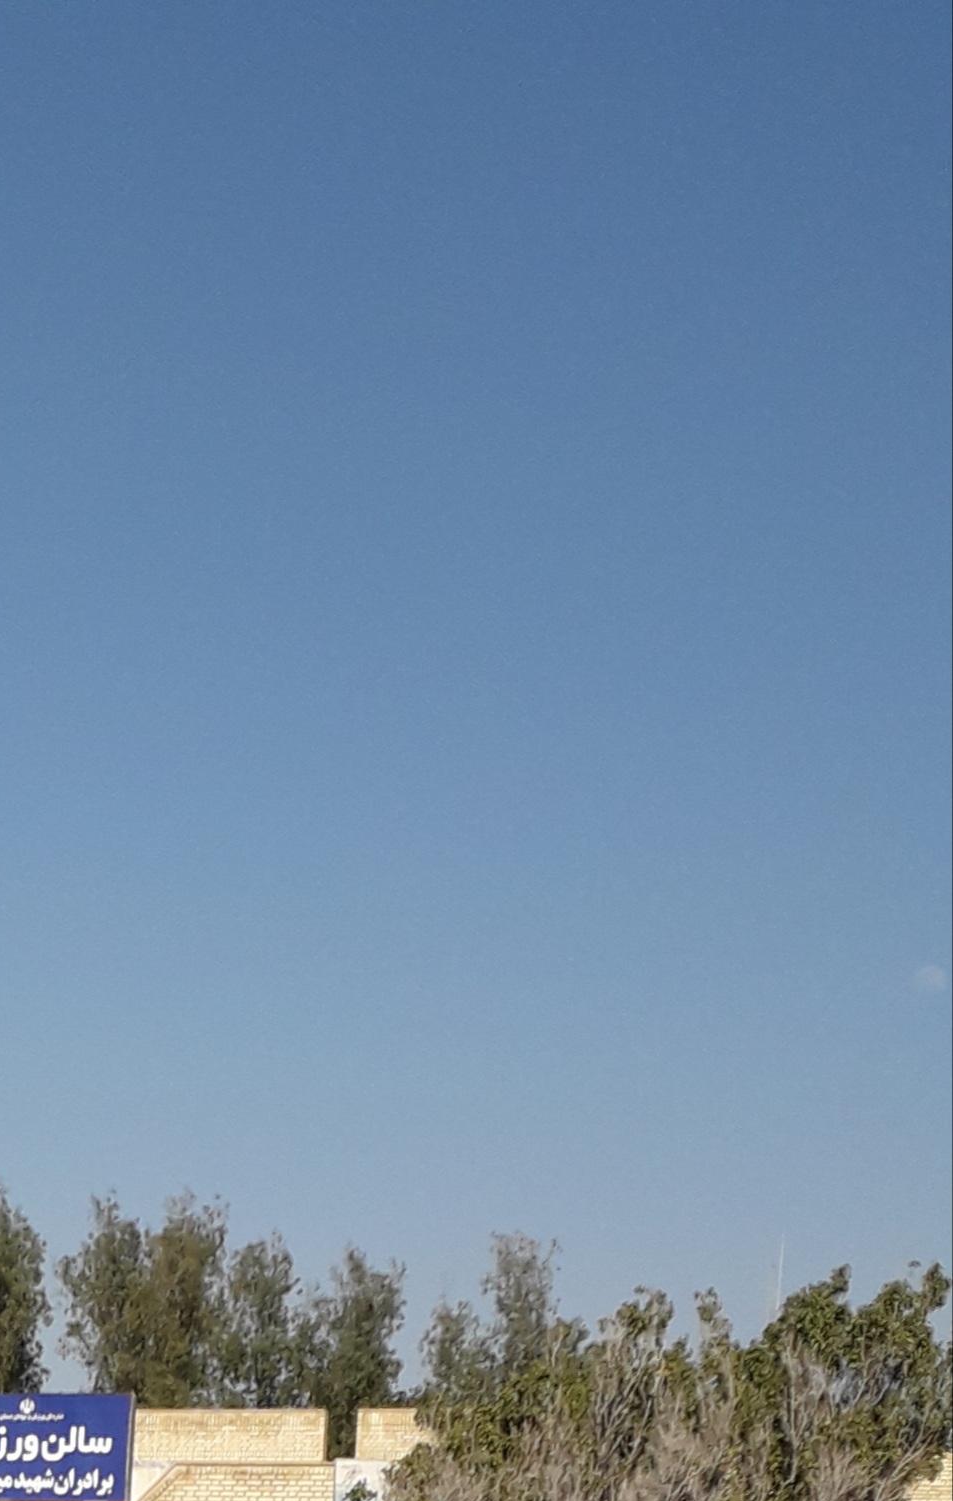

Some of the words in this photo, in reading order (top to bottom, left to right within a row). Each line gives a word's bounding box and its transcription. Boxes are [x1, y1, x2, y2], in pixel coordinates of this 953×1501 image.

[41, 1426, 113, 1461] سالن
[13, 1468, 54, 1494] شهید
[54, 1468, 114, 1495] برادران
